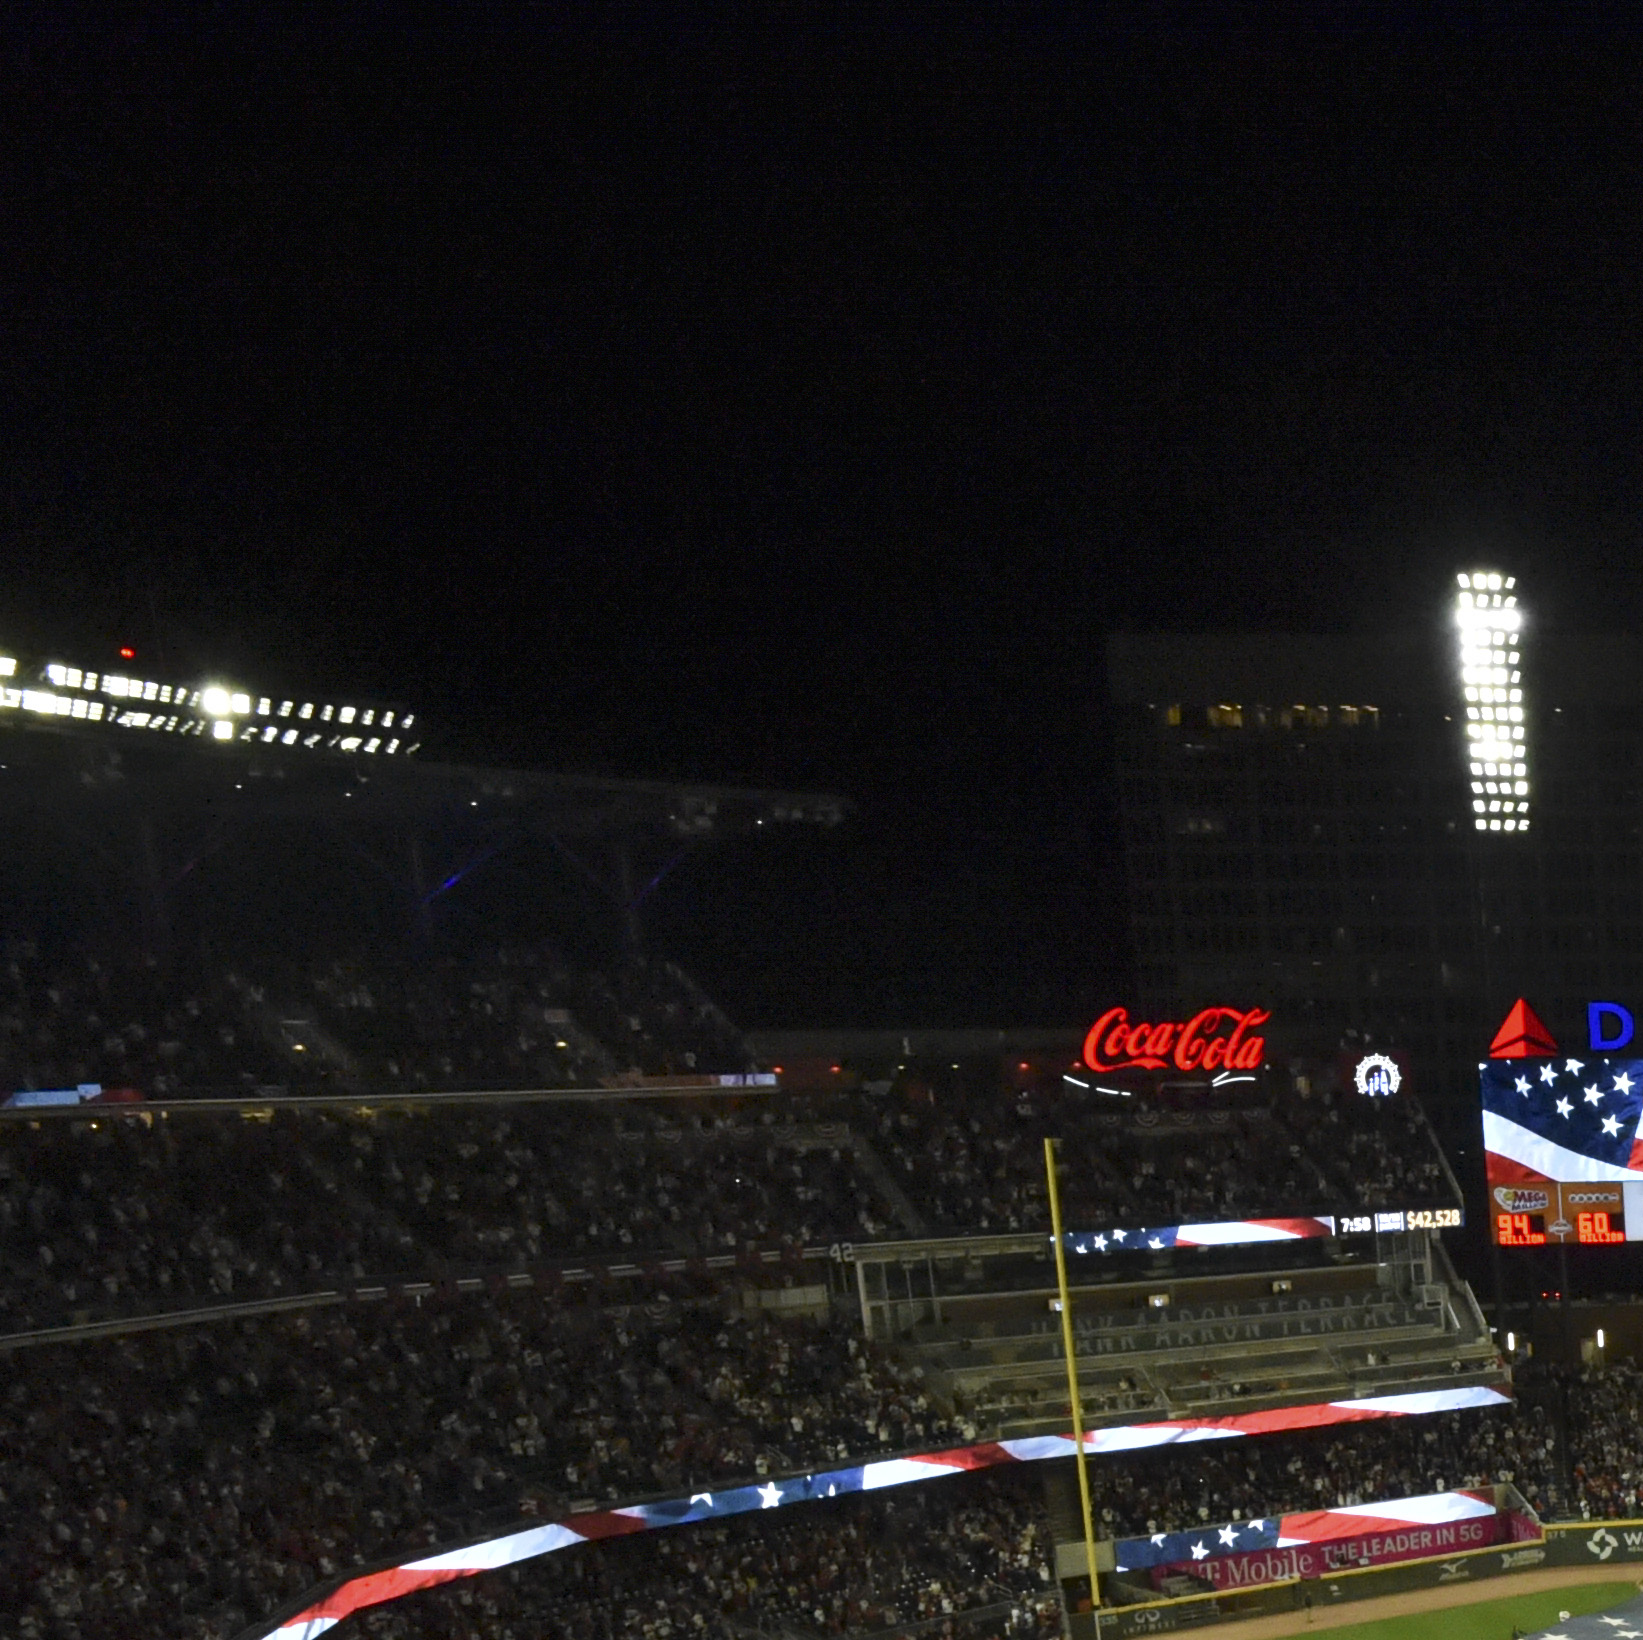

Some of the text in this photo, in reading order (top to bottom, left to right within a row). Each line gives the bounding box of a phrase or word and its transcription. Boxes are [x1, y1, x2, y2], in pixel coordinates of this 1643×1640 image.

[1084, 1006, 1271, 1072] Coca-Cola
[1340, 1216, 1371, 1232] 7:58
[1407, 1209, 1461, 1230] $42,528
[1498, 1214, 1529, 1235] 94
[1578, 1212, 1609, 1234] 60
[1322, 1522, 1483, 1565] THE LEADER IN 5G
